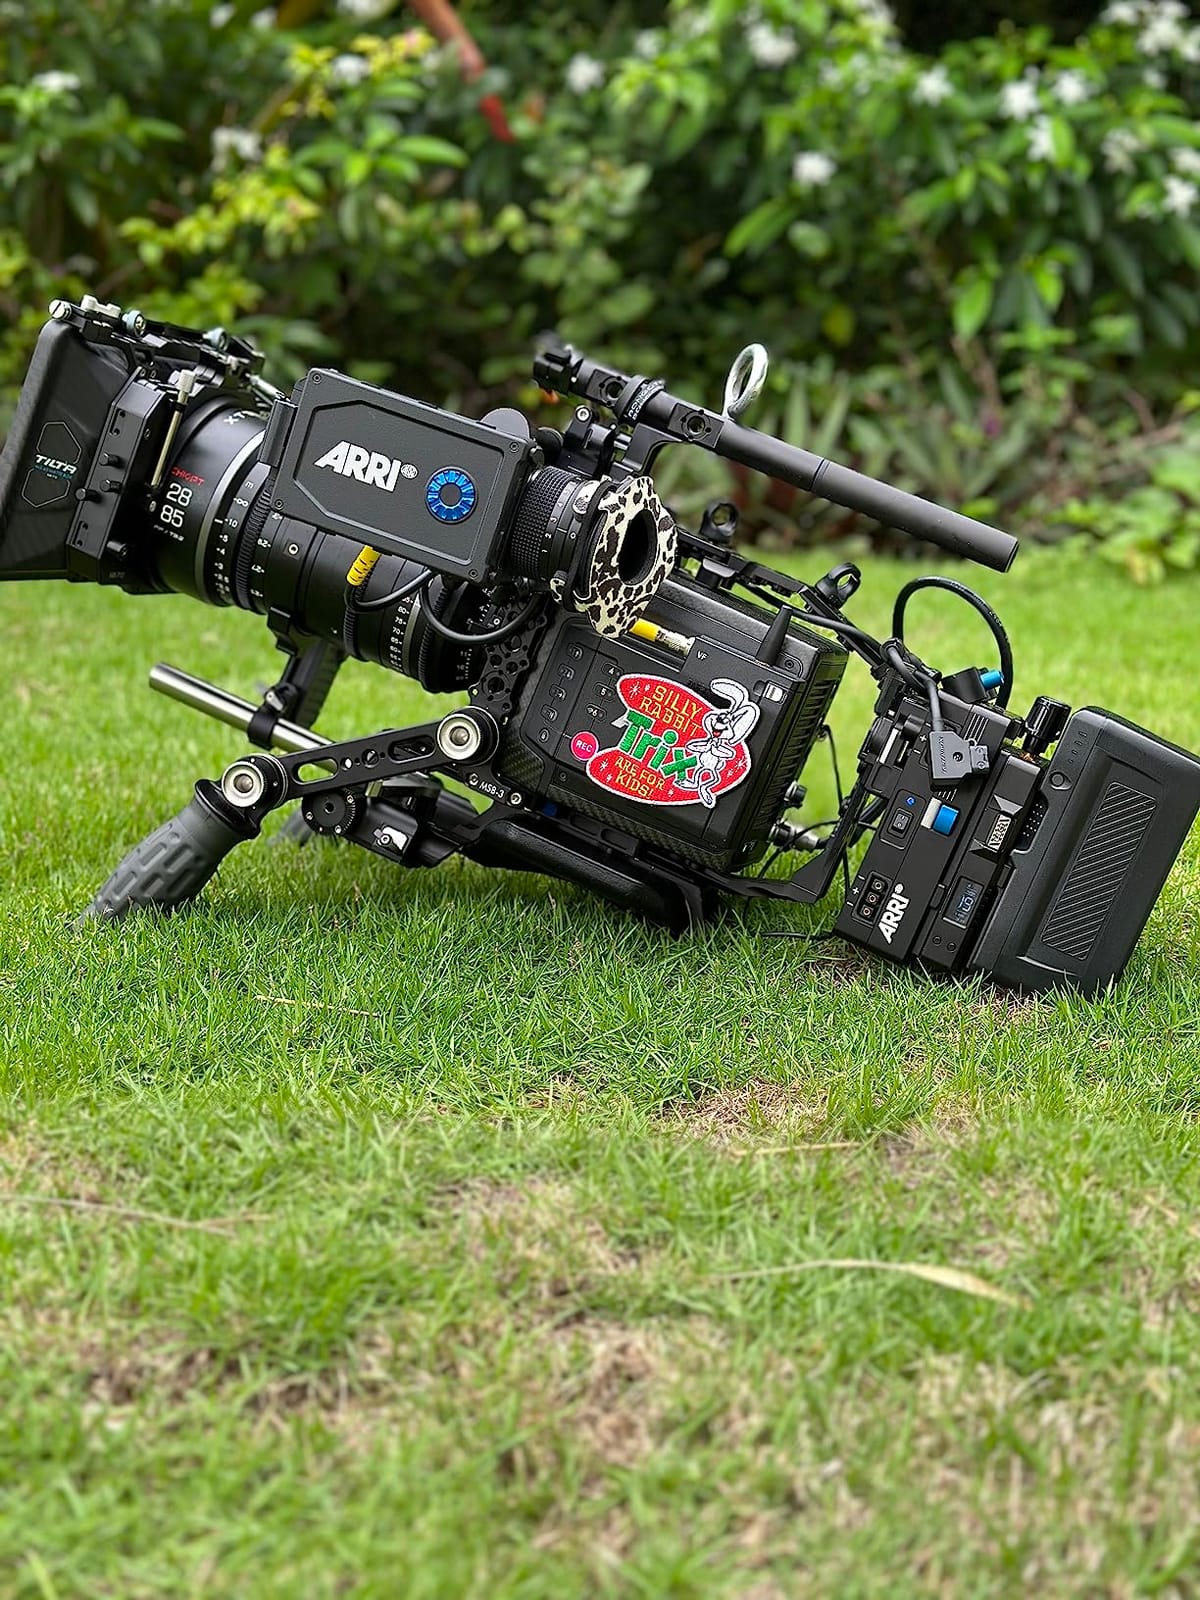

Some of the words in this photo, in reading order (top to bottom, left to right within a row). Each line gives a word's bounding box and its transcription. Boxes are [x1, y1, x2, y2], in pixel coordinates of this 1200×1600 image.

[35, 454, 77, 474] TILTA
[166, 483, 192, 507] 28
[160, 505, 185, 528] 85
[392, 626, 400, 634] 70
[696, 650, 709, 661] VF
[601, 688, 606, 696] 5
[652, 685, 702, 718] SILLY
[592, 708, 598, 716] 6
[640, 698, 701, 737] RABBIT
[576, 740, 592, 752] REC
[617, 711, 698, 782] Trix
[615, 756, 640, 777] ARE
[639, 771, 666, 791] FOR
[479, 781, 505, 798] MSB-3
[615, 770, 654, 799] KIDS!
